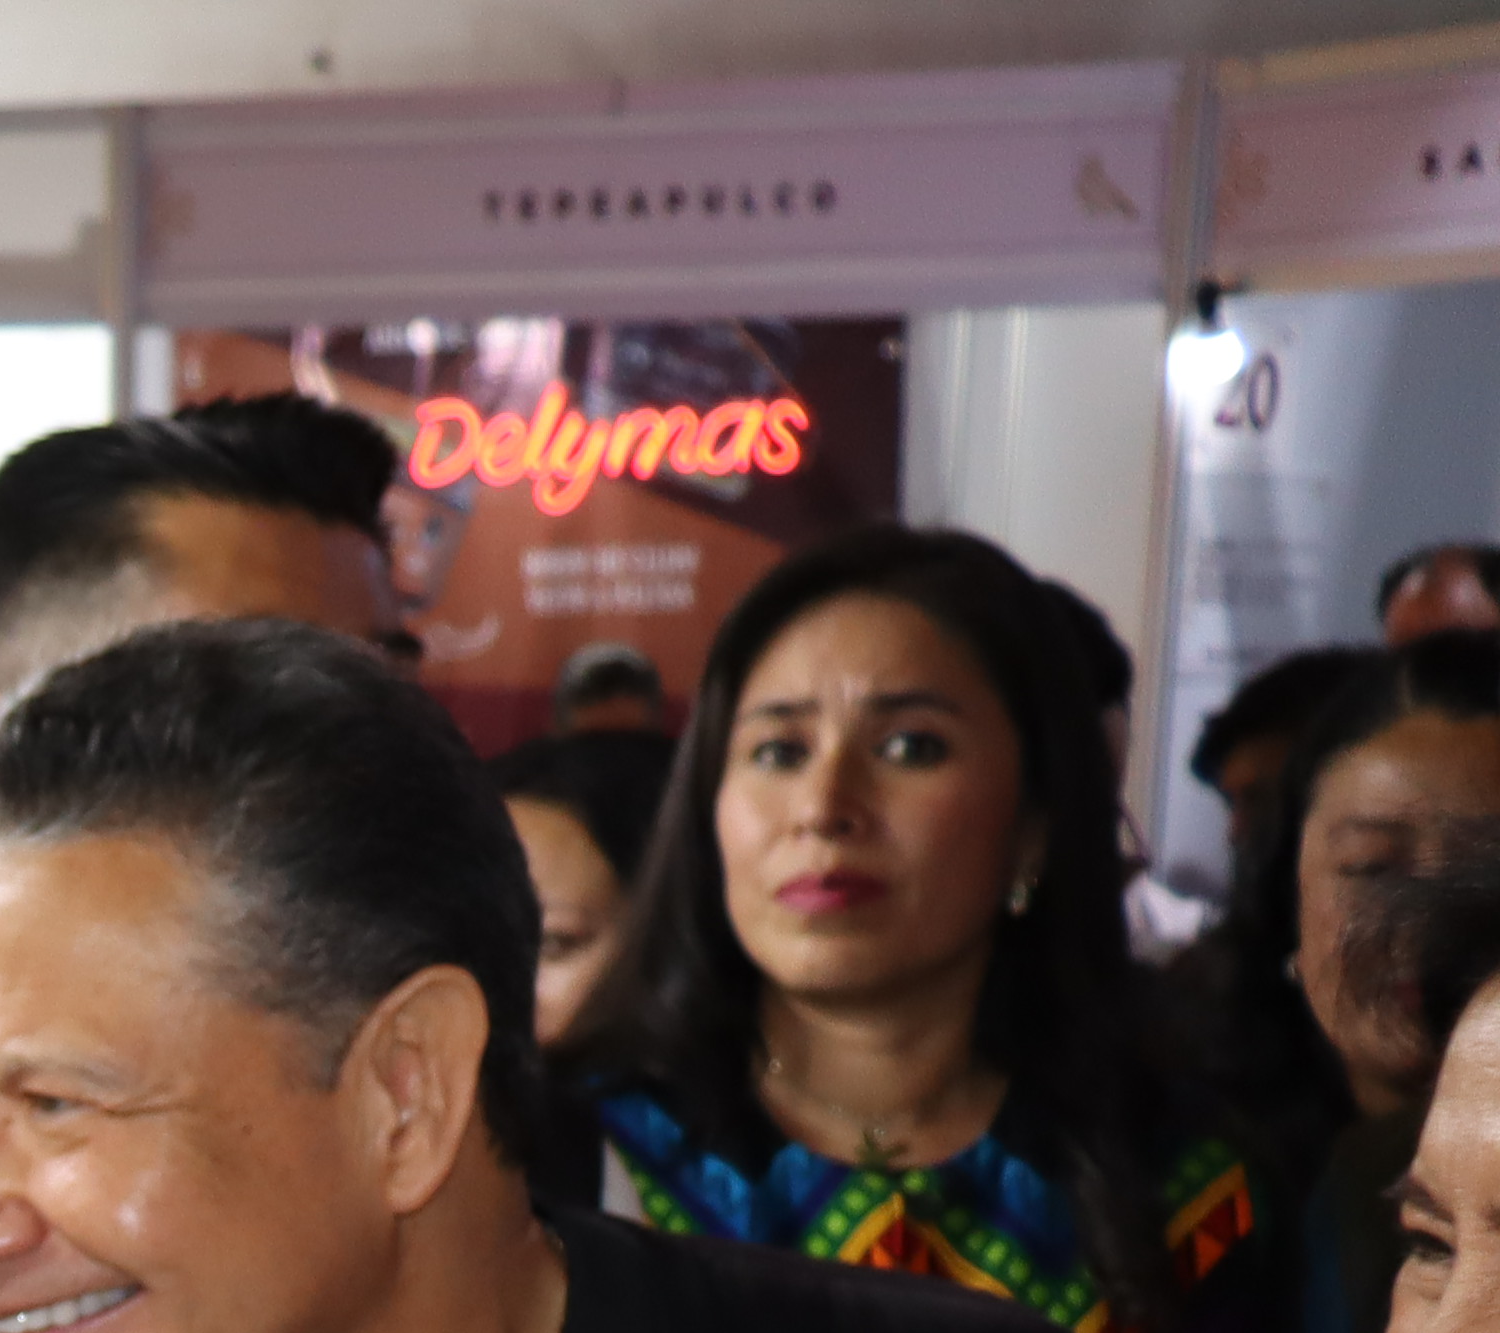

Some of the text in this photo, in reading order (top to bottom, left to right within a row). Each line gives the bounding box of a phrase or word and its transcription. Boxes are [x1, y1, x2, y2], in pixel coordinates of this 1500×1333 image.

[1420, 143, 1483, 182] BA
[481, 177, 838, 226] TEPEAPULCO
[408, 380, 809, 516] Delymas
